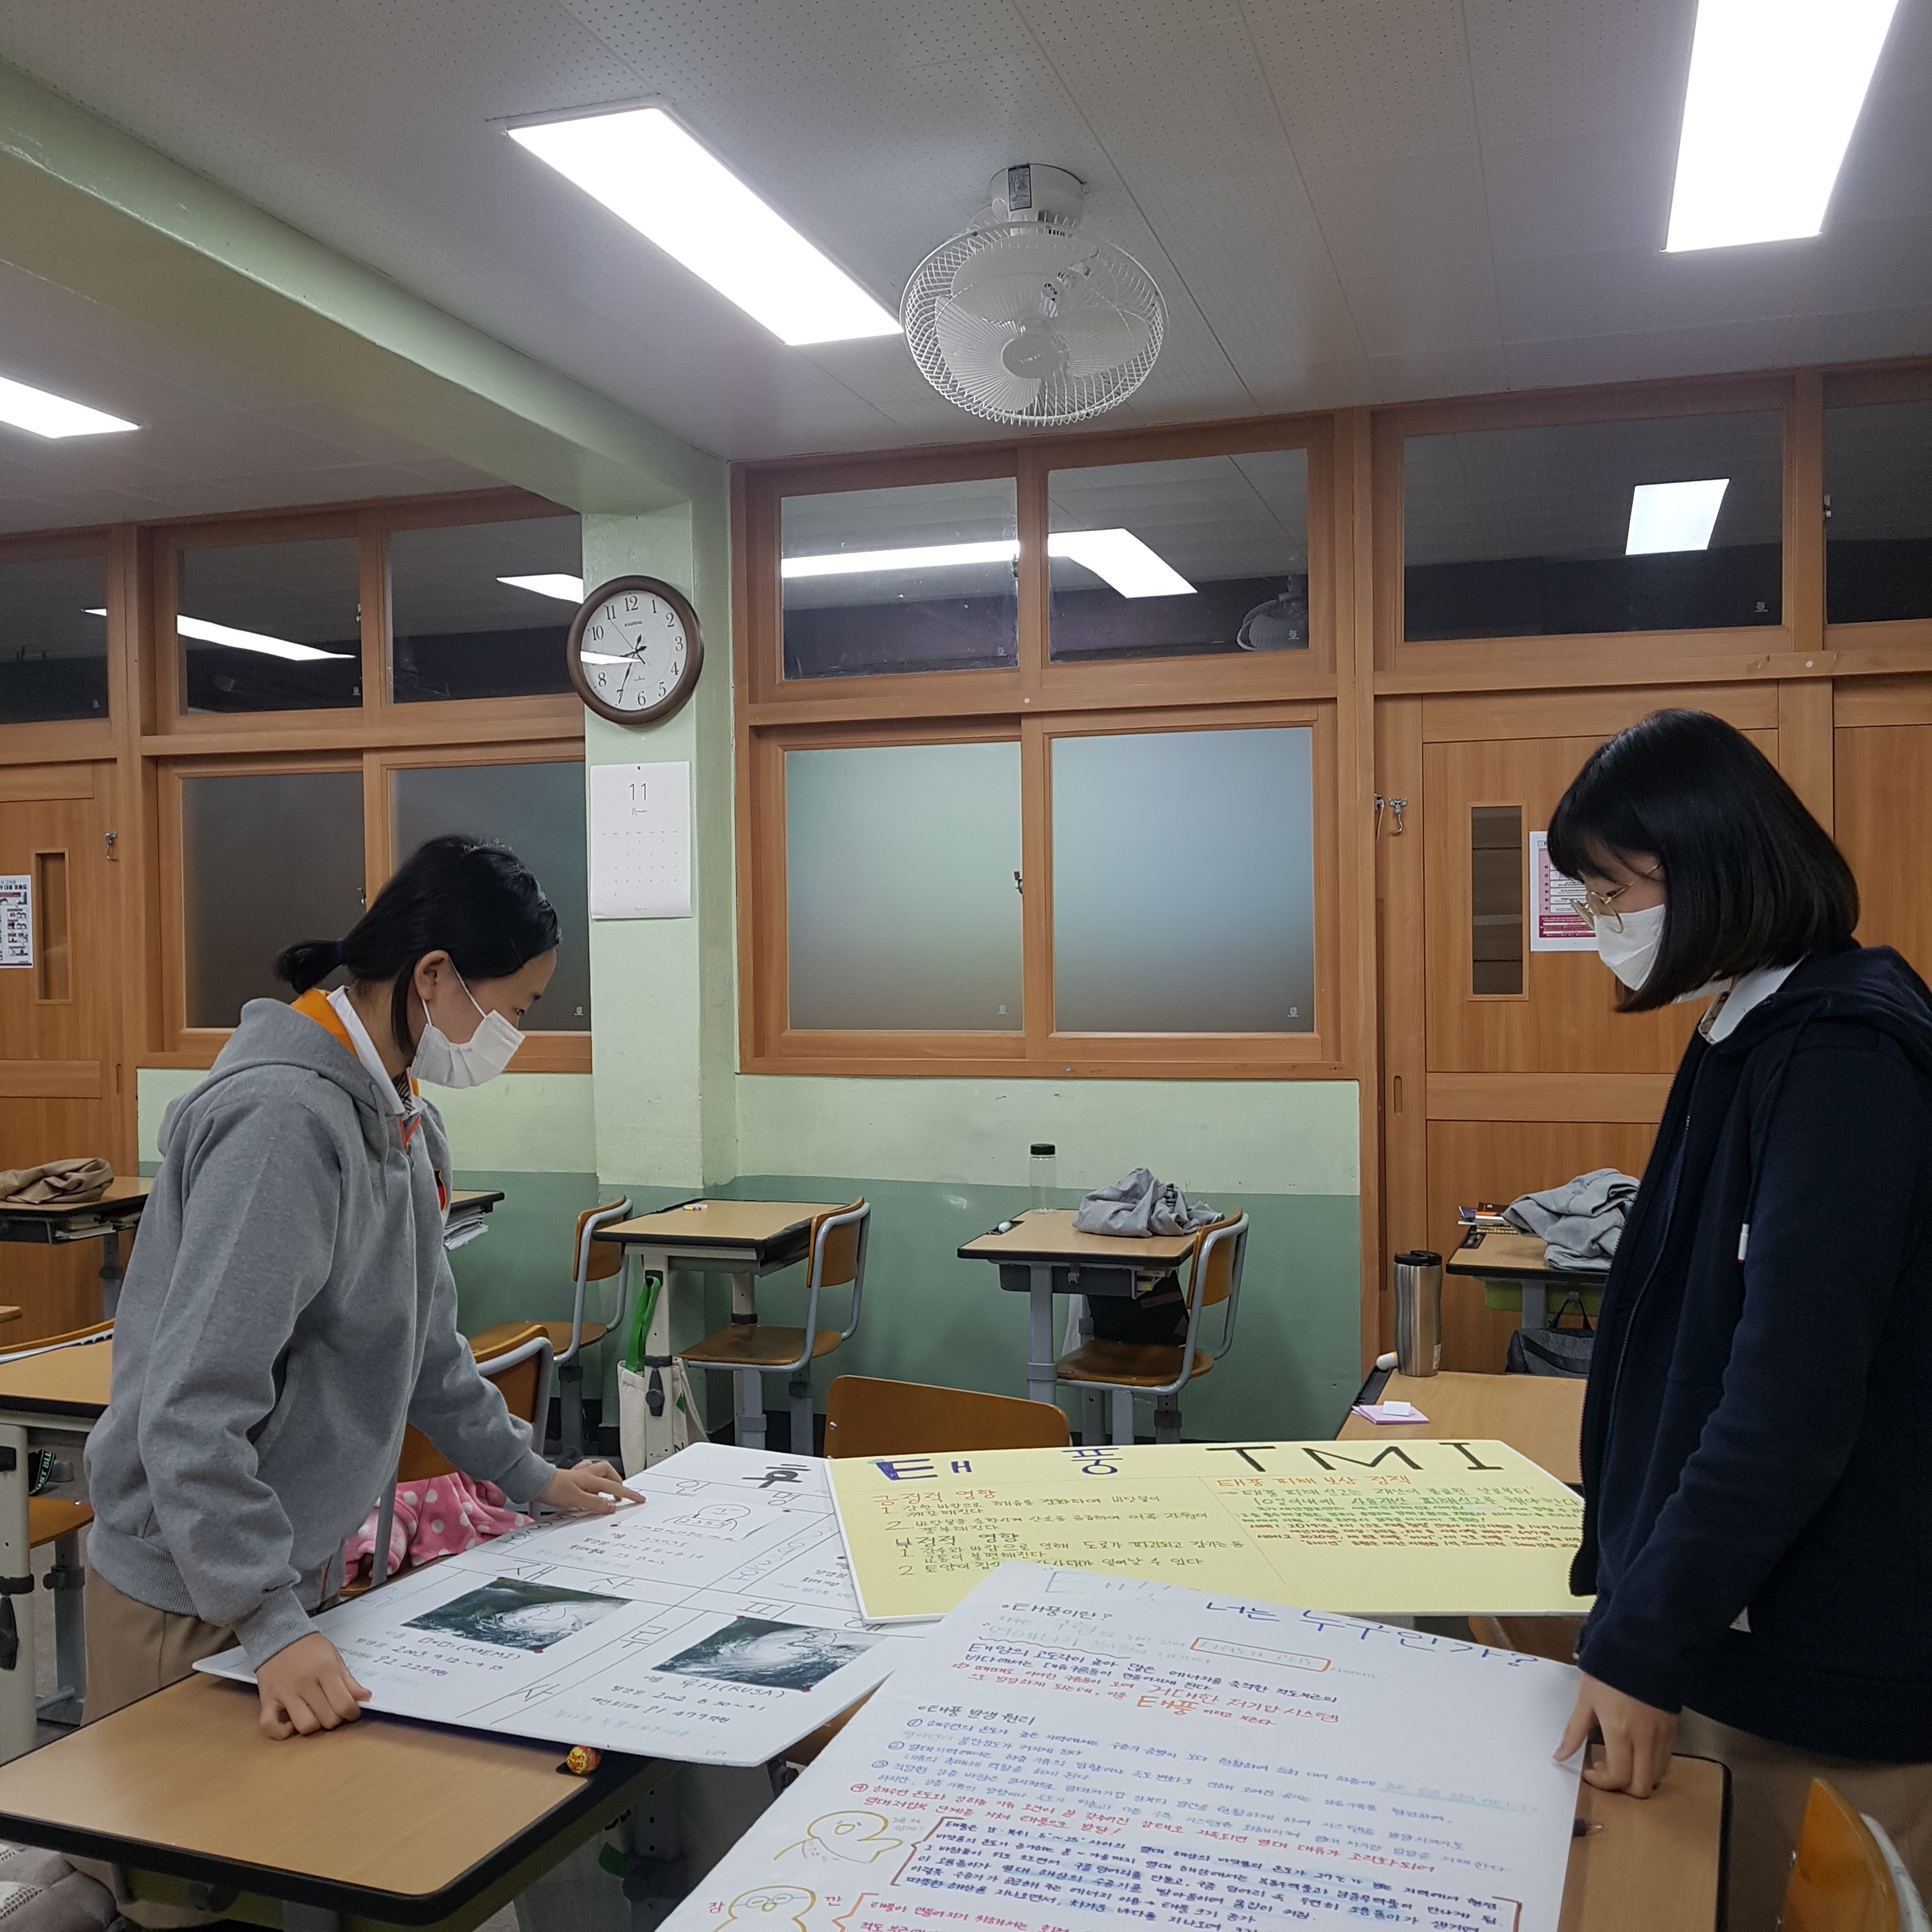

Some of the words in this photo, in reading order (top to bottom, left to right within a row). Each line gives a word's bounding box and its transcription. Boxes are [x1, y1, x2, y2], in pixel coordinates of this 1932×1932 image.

[625, 595, 639, 611] 12
[651, 598, 657, 614] 1
[606, 604, 616, 620] 11
[665, 612, 675, 628] 2
[590, 624, 604, 641] 10
[675, 636, 684, 652] 3
[670, 661, 680, 676] 4
[597, 671, 606, 687] 8
[657, 681, 667, 698] 5
[637, 691, 646, 707] 6
[629, 782, 648, 801] 11
[1205, 1442, 1503, 1472] TMI
[1217, 1478, 1263, 1487] 태풍
[1272, 1477, 1317, 1485] 피해
[872, 1492, 942, 1506] 긍정적
[956, 1489, 996, 1501] 영향
[978, 1533, 1020, 1544] 영향
[1083, 1540, 1123, 1549] 도로가
[1206, 1602, 1280, 1622] 너는
[968, 1643, 1029, 1657] 태양의
[927, 1705, 962, 1718] 태풍
[1137, 1695, 1199, 1716] 태풍
